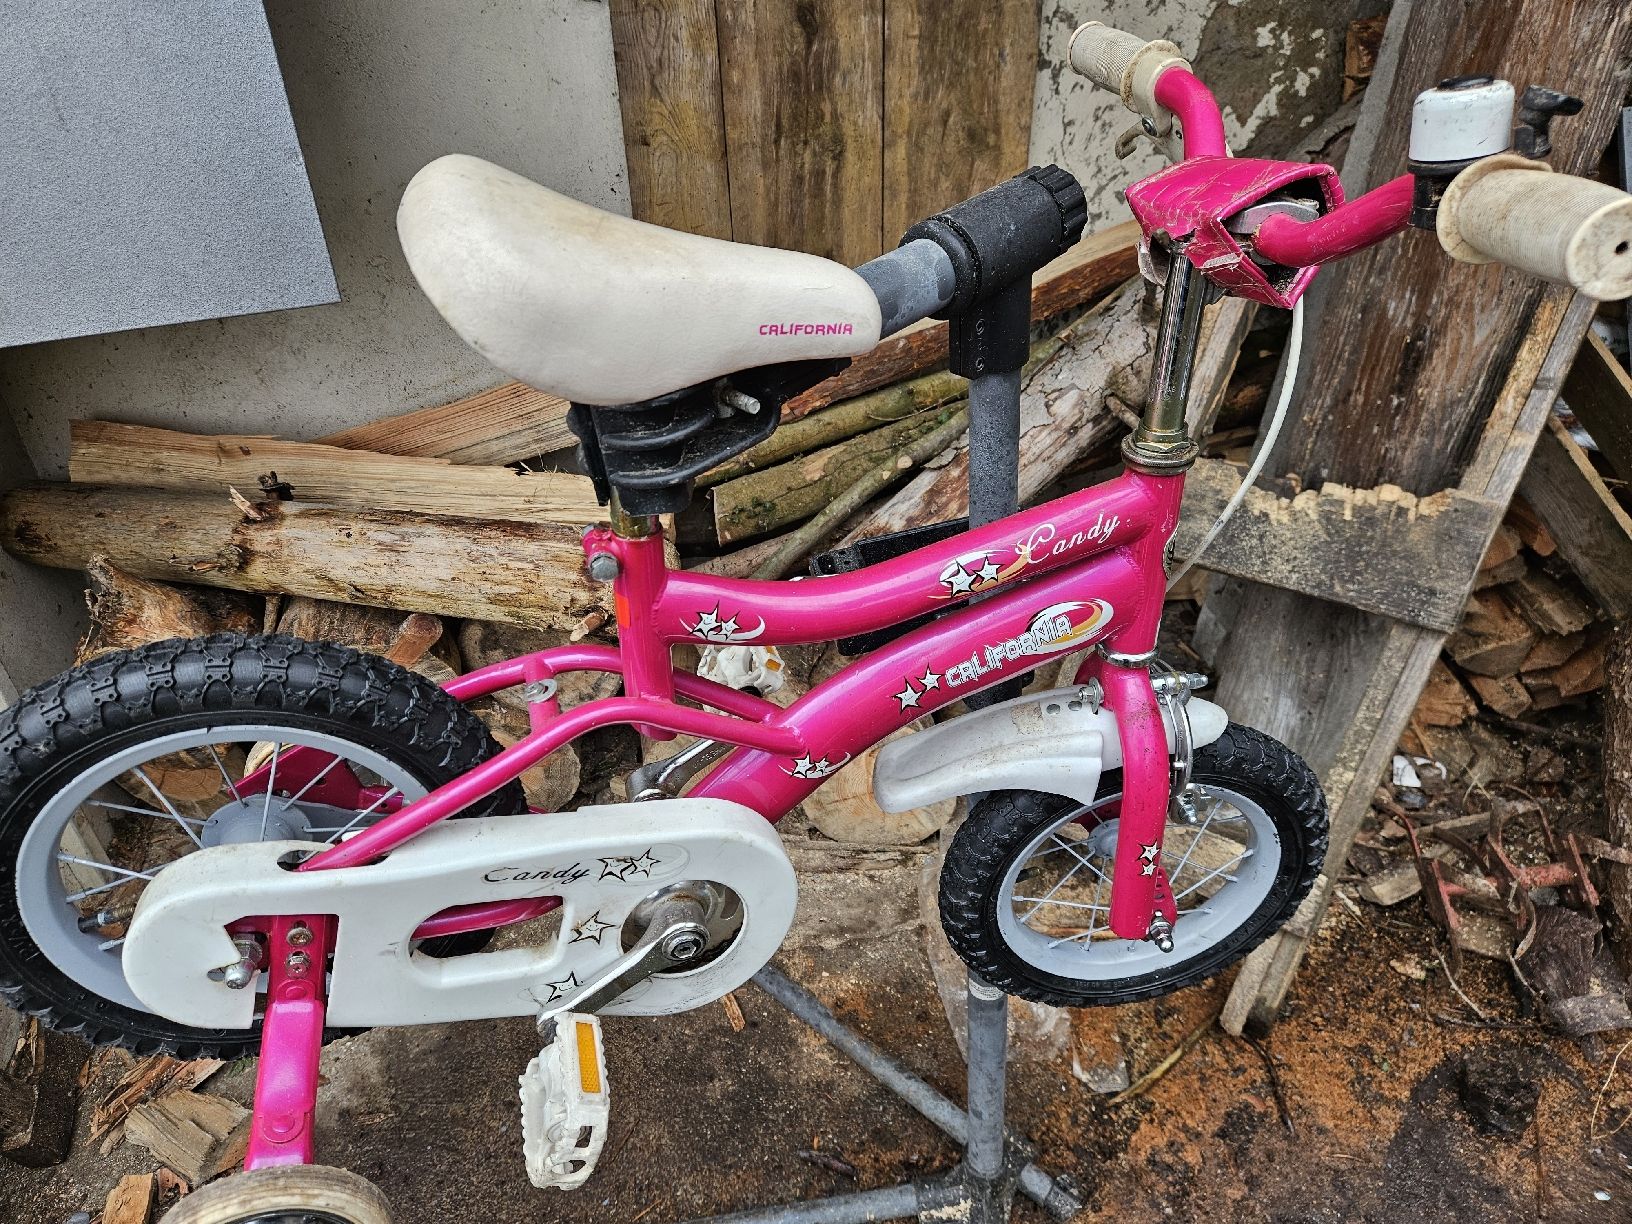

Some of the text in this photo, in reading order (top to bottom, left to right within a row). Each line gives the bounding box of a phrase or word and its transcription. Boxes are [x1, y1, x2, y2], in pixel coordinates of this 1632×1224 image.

[759, 323, 853, 336] CALIFORNIA
[1014, 511, 1121, 564] Candy
[944, 614, 1073, 688] CALIFORNIA
[483, 862, 590, 885] Candy
